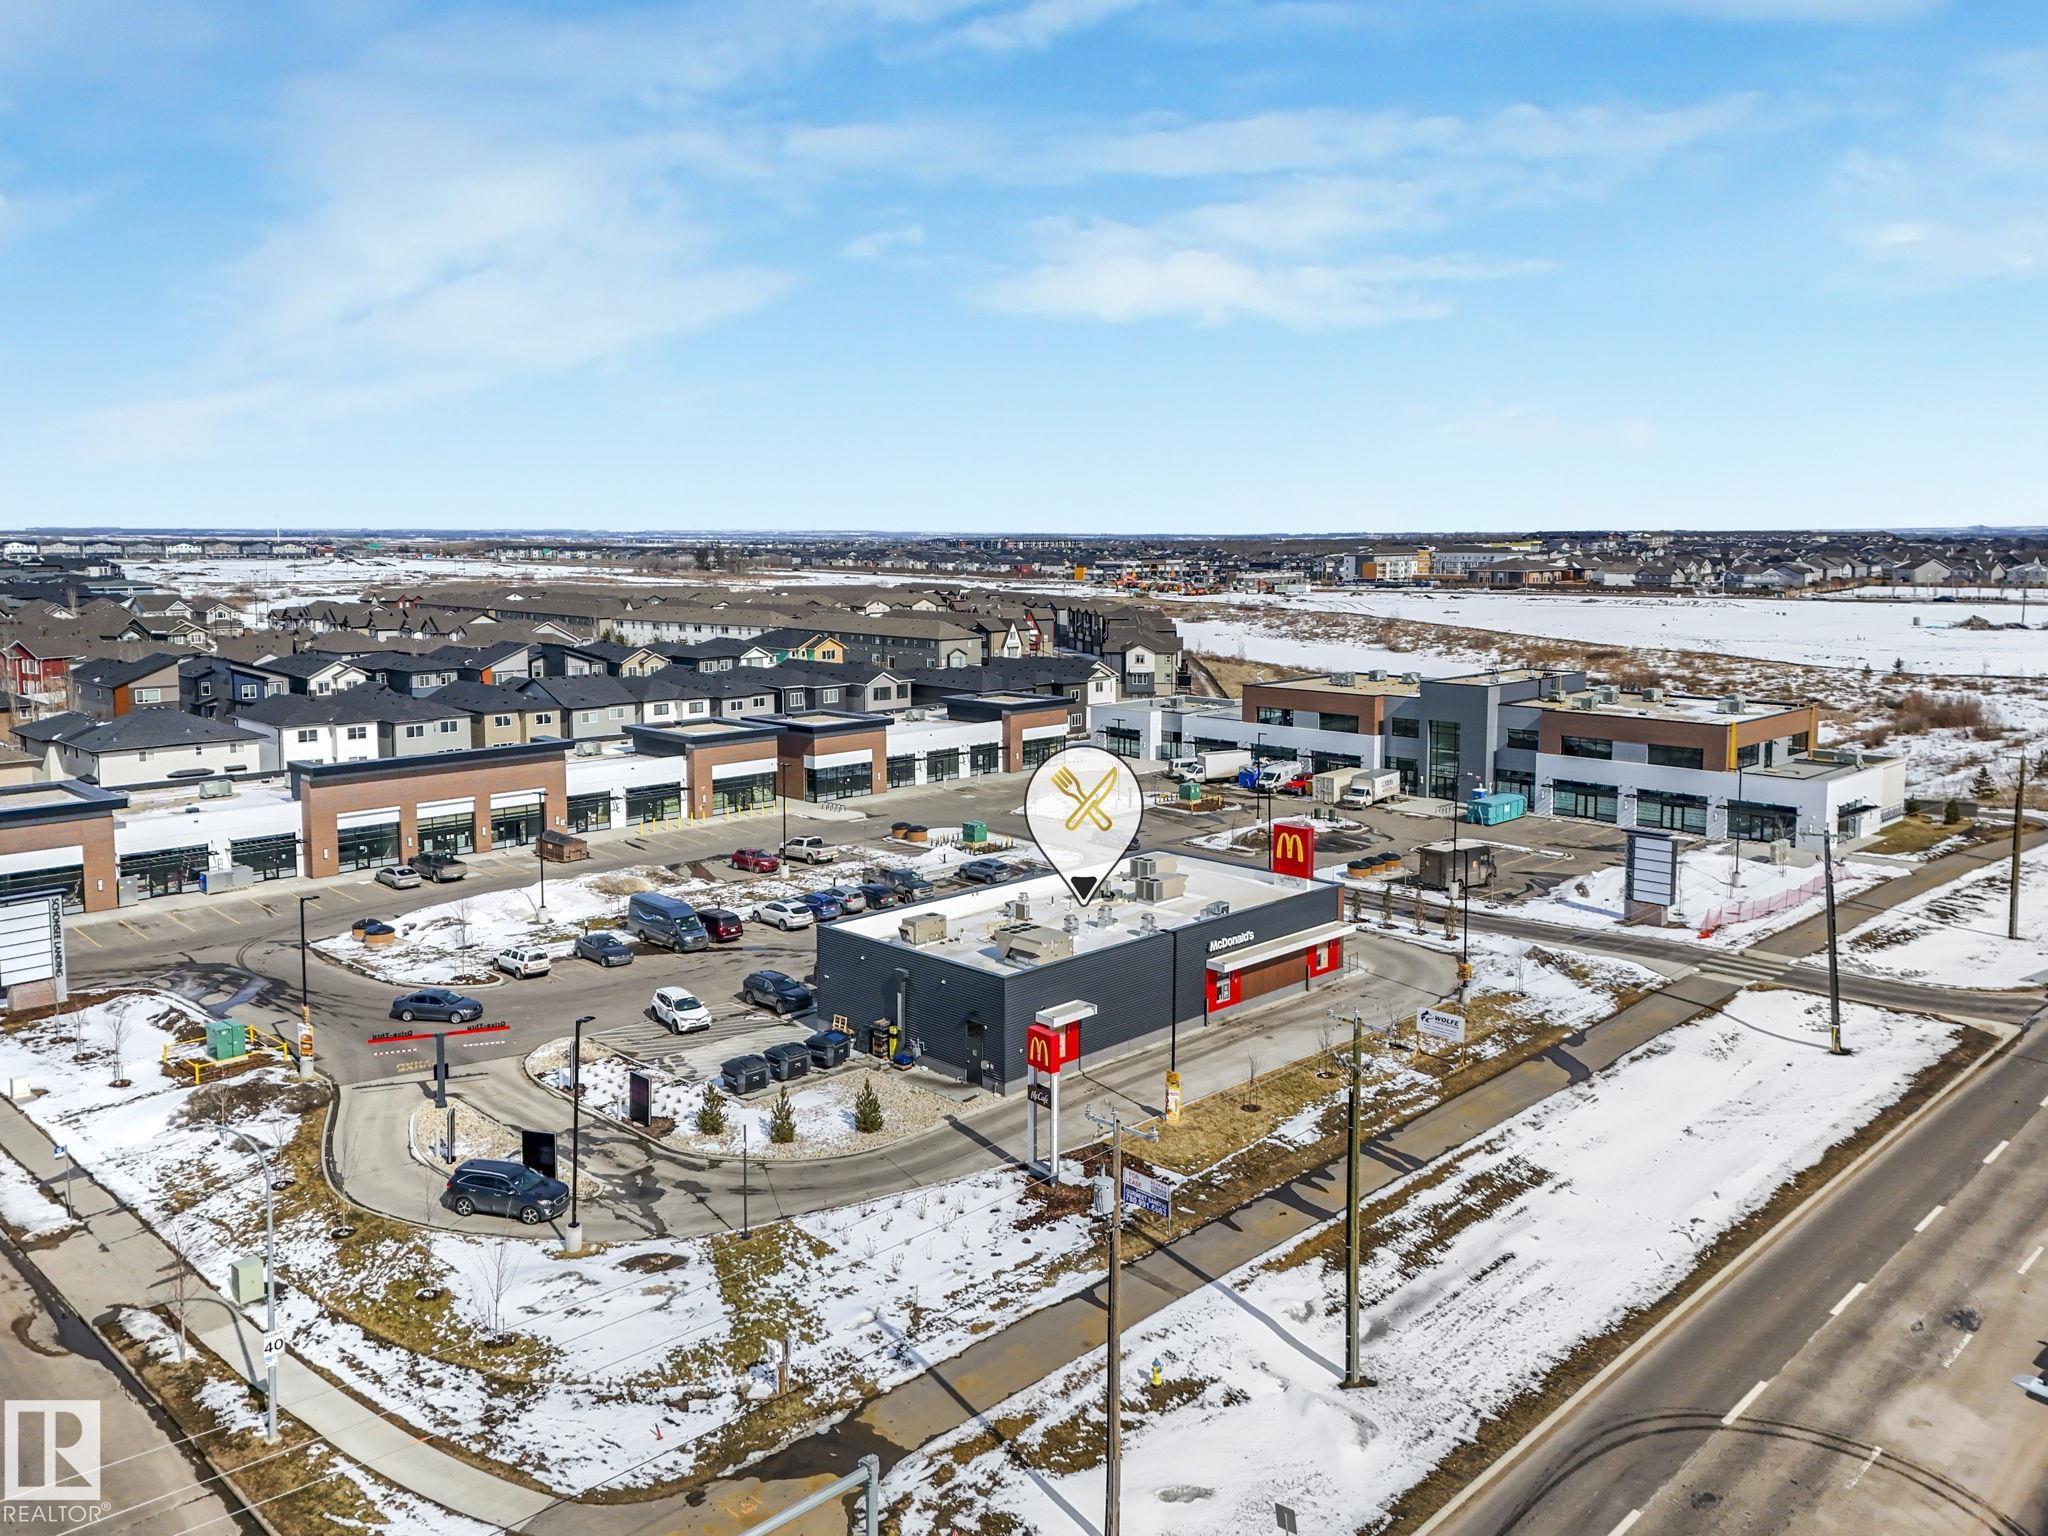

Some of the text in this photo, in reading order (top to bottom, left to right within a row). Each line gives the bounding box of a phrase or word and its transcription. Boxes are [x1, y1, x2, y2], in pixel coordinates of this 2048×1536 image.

[1209, 930, 1255, 952] McDonald's
[54, 941, 63, 978] LANDING
[1434, 1015, 1460, 1027] WOLFE
[1125, 1176, 1142, 1189] LEASE
[1128, 1170, 1140, 1181] FOR
[264, 1338, 284, 1353] 40
